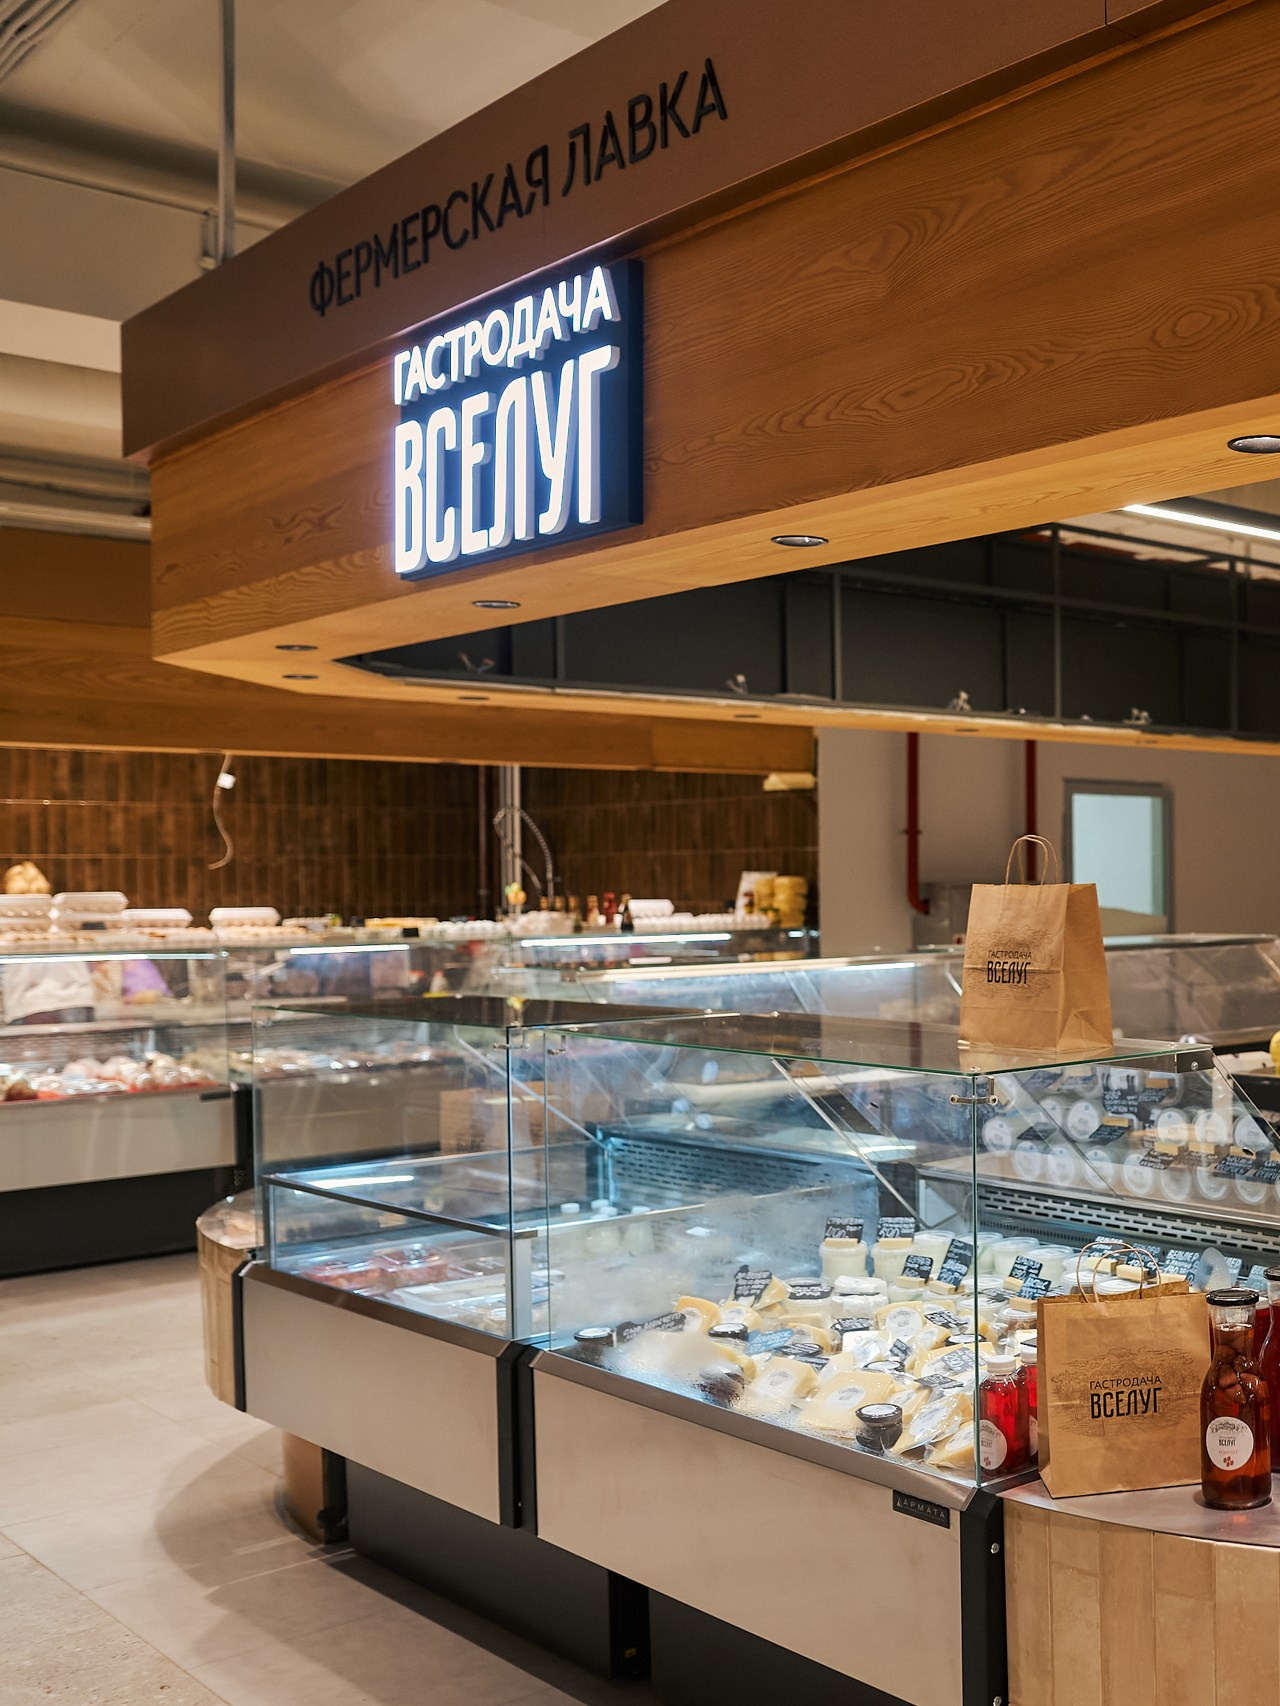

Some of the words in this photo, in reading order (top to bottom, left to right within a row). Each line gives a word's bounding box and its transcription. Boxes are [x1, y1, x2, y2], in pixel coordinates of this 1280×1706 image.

[309, 144, 550, 317] ФЕРМЕРСКАЯ
[561, 58, 728, 197] ЛАВКА
[394, 265, 616, 405] ГАСТРОДАЧА
[394, 345, 617, 574] ВСЕЛУГ
[988, 950, 1032, 959] ГАСТРОДАЧА
[987, 961, 1031, 984] ВСЕЛУГ
[1089, 1375, 1162, 1390] ГАСТРОДАЧА
[1090, 1387, 1162, 1419] ВСЕЛУГ
